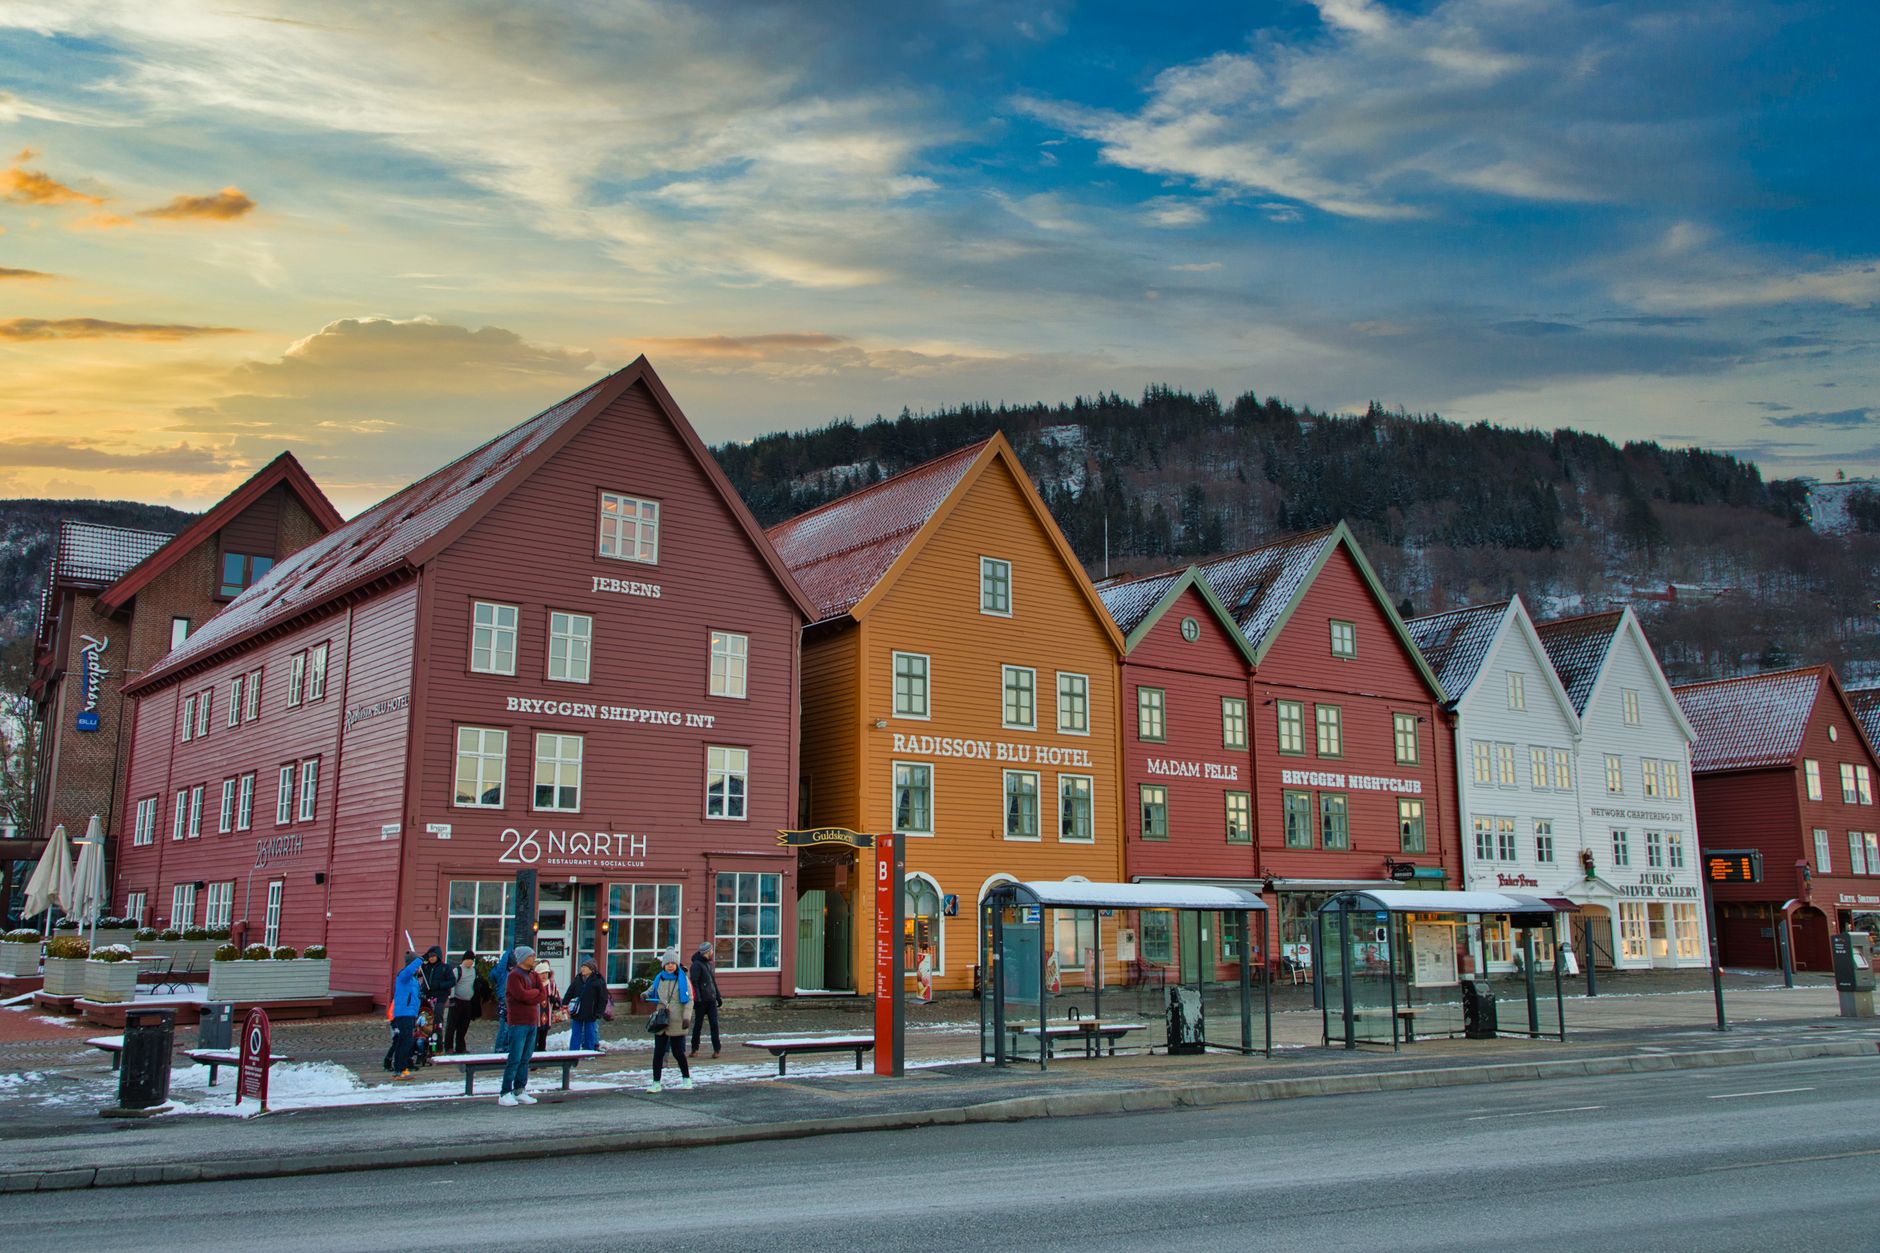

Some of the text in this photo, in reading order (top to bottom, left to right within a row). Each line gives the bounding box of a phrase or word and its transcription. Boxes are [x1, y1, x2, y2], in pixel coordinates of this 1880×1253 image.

[592, 576, 661, 598] JEBSENS
[80, 634, 109, 711] Radisson
[387, 696, 409, 711] HOTEL
[506, 696, 715, 729] BRYGGEN SHIPPING INT
[893, 733, 1092, 767] RADISSON BLU HOTEL
[1147, 758, 1238, 780] MADAM FELLE
[1282, 770, 1421, 793] BRYGGEN NIGHTCLUB
[1591, 808, 1626, 818] NETWORK
[1627, 810, 1670, 821] CHARTERING
[255, 834, 303, 869] 26 NORTH
[498, 828, 646, 863] 26 NORTH
[880, 861, 887, 880] B
[1619, 885, 1697, 897] SILVER GALLERY
